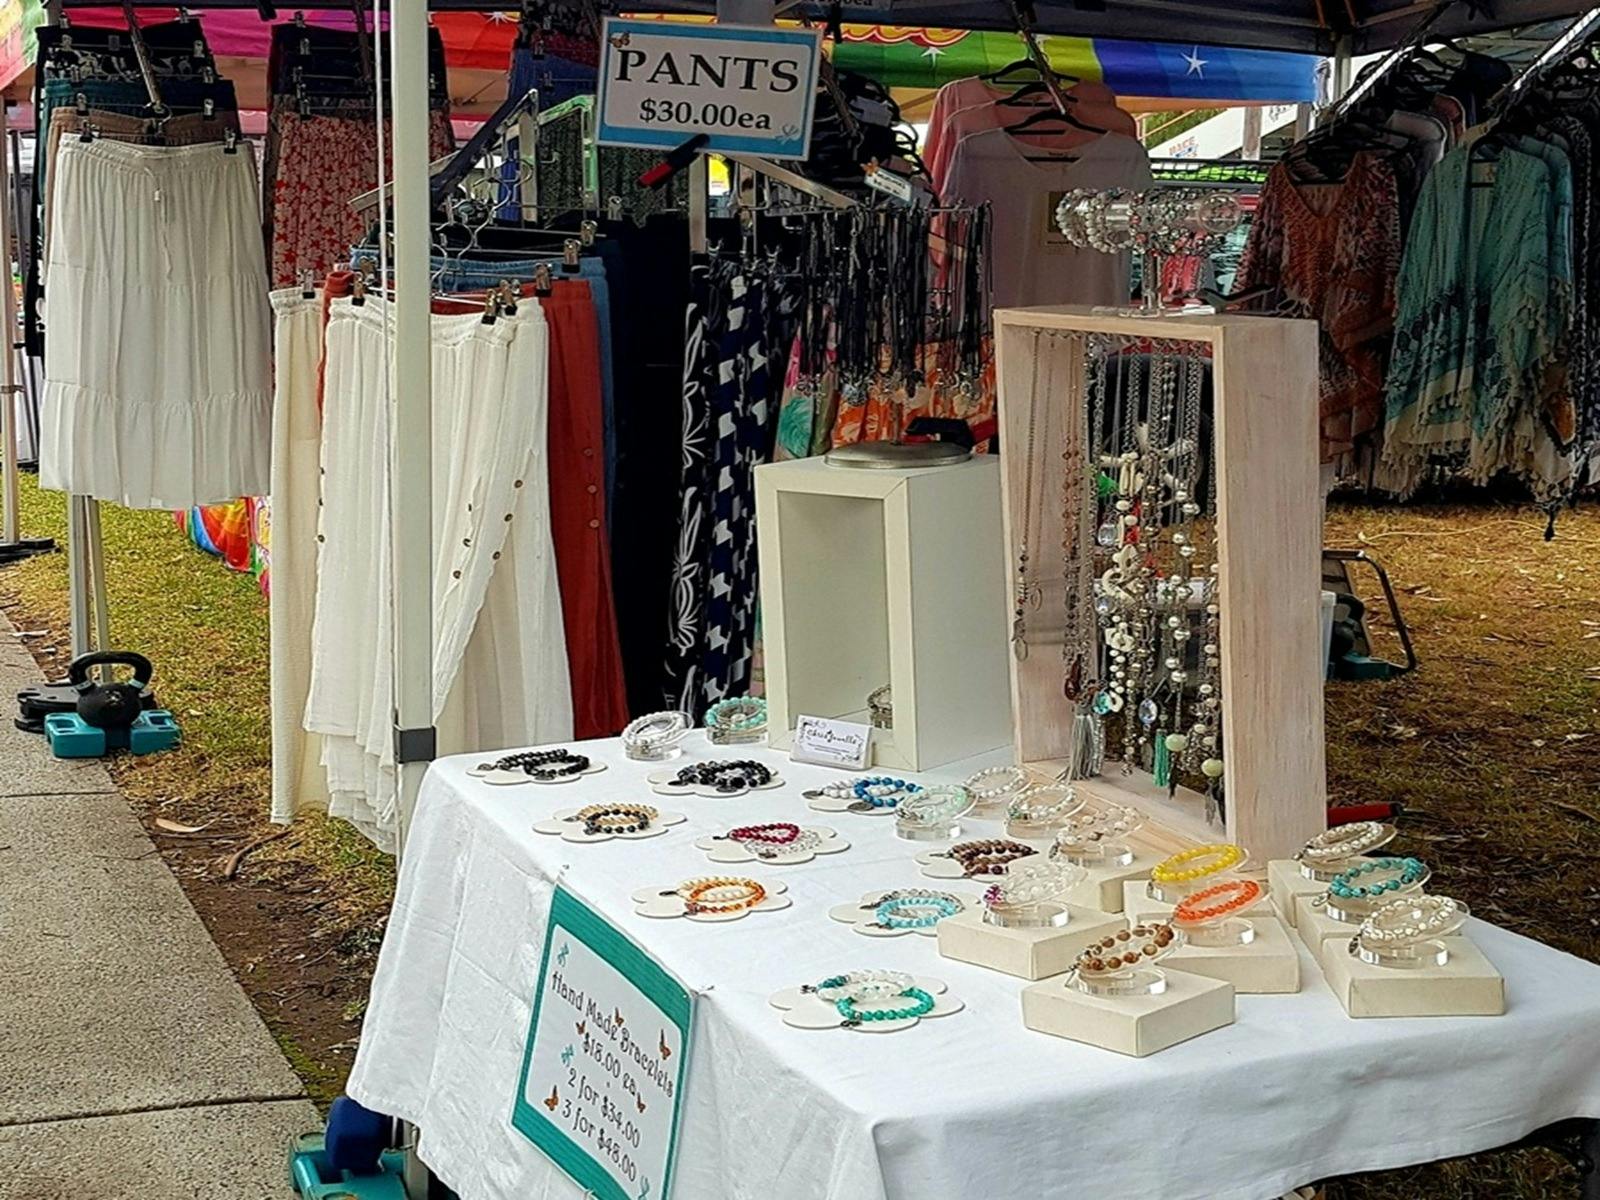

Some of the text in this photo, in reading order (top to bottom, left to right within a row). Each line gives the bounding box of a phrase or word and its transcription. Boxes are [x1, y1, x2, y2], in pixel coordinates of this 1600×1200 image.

[614, 49, 800, 93] PANTS
[639, 98, 772, 131] $30.00ea
[552, 971, 674, 1098] Hand Made Bracelets
[562, 1099, 637, 1183] 3 for $48.00
[567, 1067, 641, 1149] 2 for $34.00
